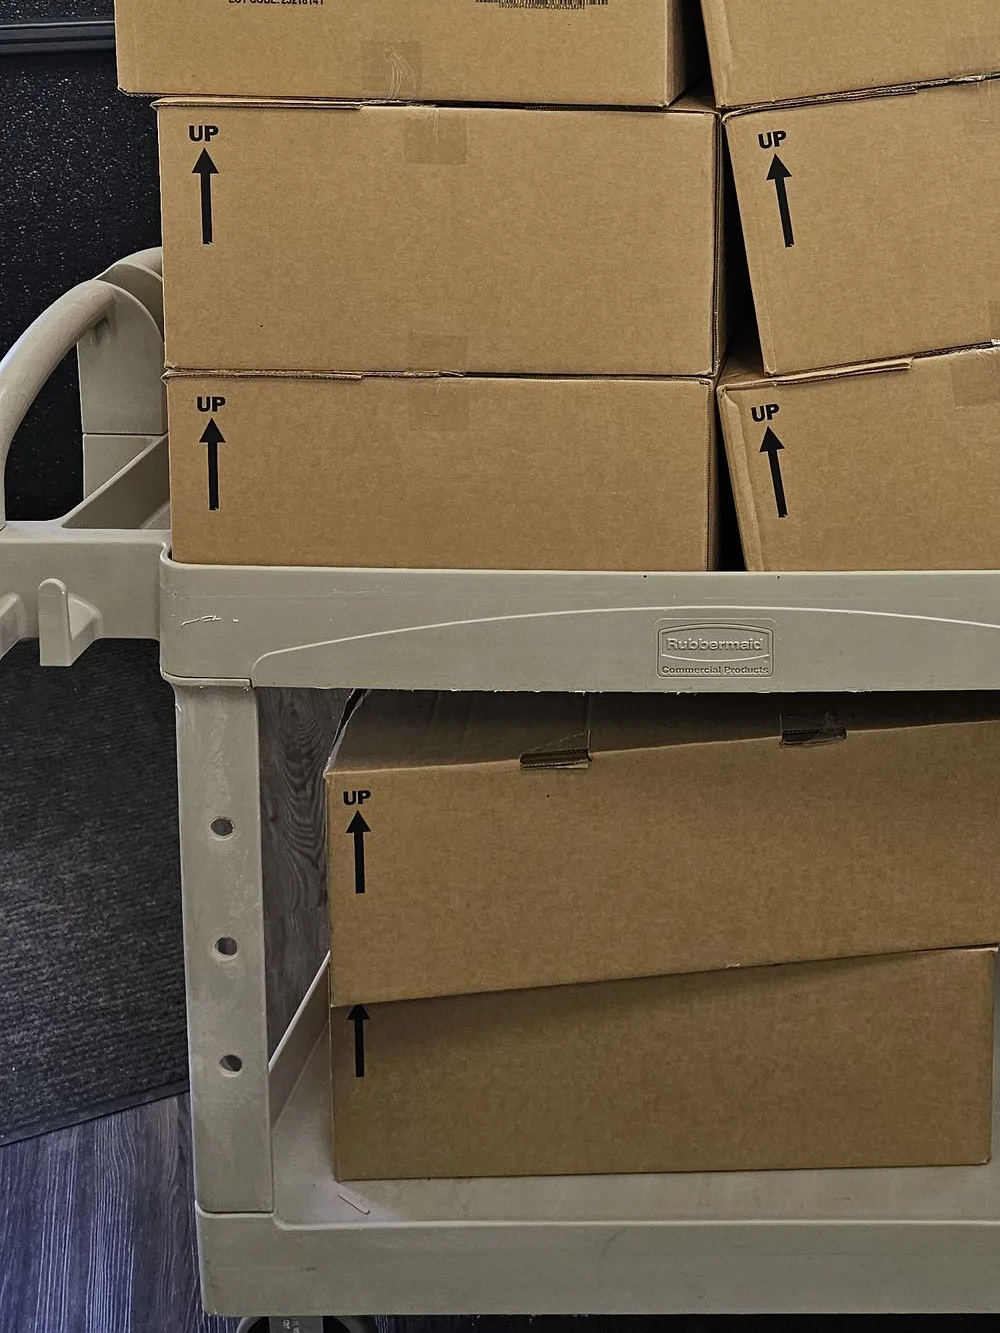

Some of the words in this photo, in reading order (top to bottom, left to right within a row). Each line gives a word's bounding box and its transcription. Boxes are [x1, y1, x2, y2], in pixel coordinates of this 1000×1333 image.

[189, 126, 218, 141] UP
[758, 131, 786, 148] UP
[197, 397, 225, 412] UP
[751, 404, 779, 422] UP
[667, 637, 764, 651] Rubbermaid
[661, 665, 721, 675] Commercial
[724, 665, 769, 675] Products
[343, 790, 371, 805] UP
